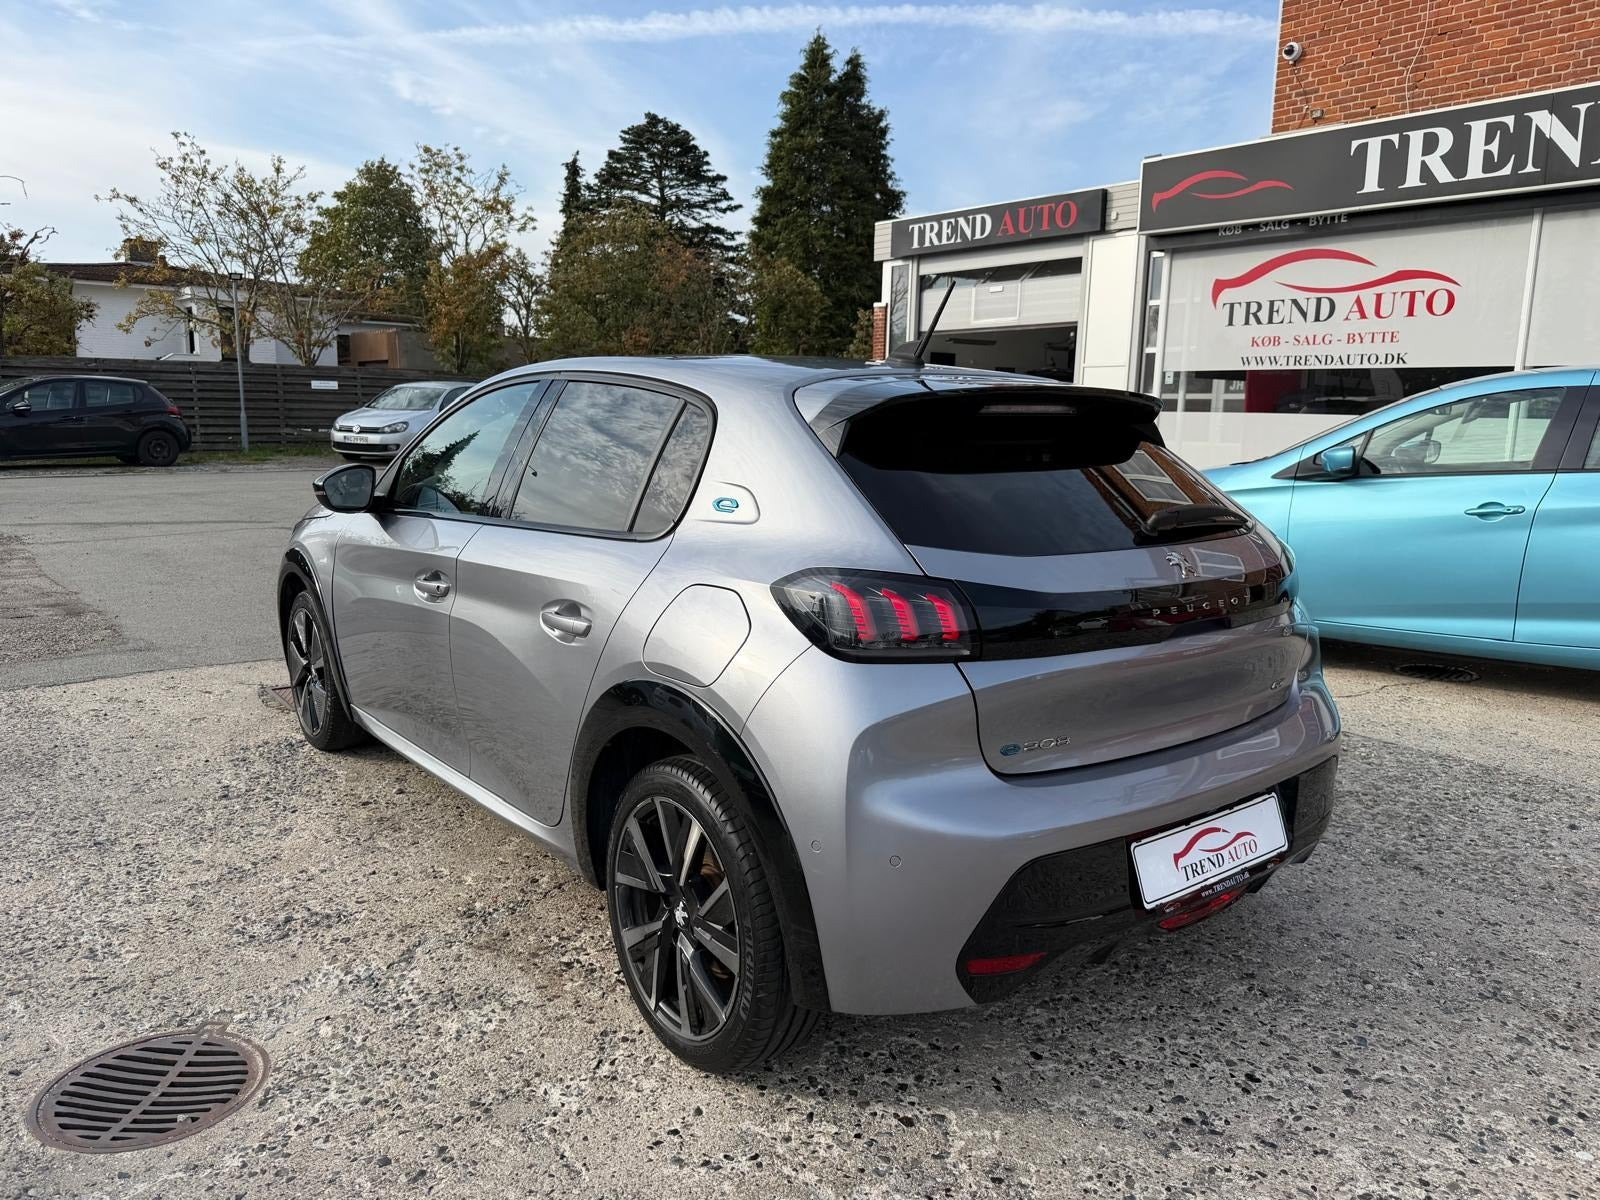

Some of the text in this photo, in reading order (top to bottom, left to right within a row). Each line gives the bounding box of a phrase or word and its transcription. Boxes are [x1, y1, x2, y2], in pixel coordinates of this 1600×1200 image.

[1351, 101, 1600, 194] TREN
[909, 200, 1078, 249] TREND AUTO
[1218, 224, 1242, 236] KØB
[1259, 219, 1290, 232] SALG
[1308, 213, 1348, 226] BYTTE
[1223, 288, 1456, 327] TREND AUTO
[1250, 335, 1281, 347] KØB
[1292, 333, 1333, 346] SALG
[1346, 330, 1400, 344] BYTTE
[1240, 352, 1408, 367] WWW.TRENDAUTO.DK
[1181, 852, 1225, 882] TREND
[1227, 839, 1258, 864] AUTO
